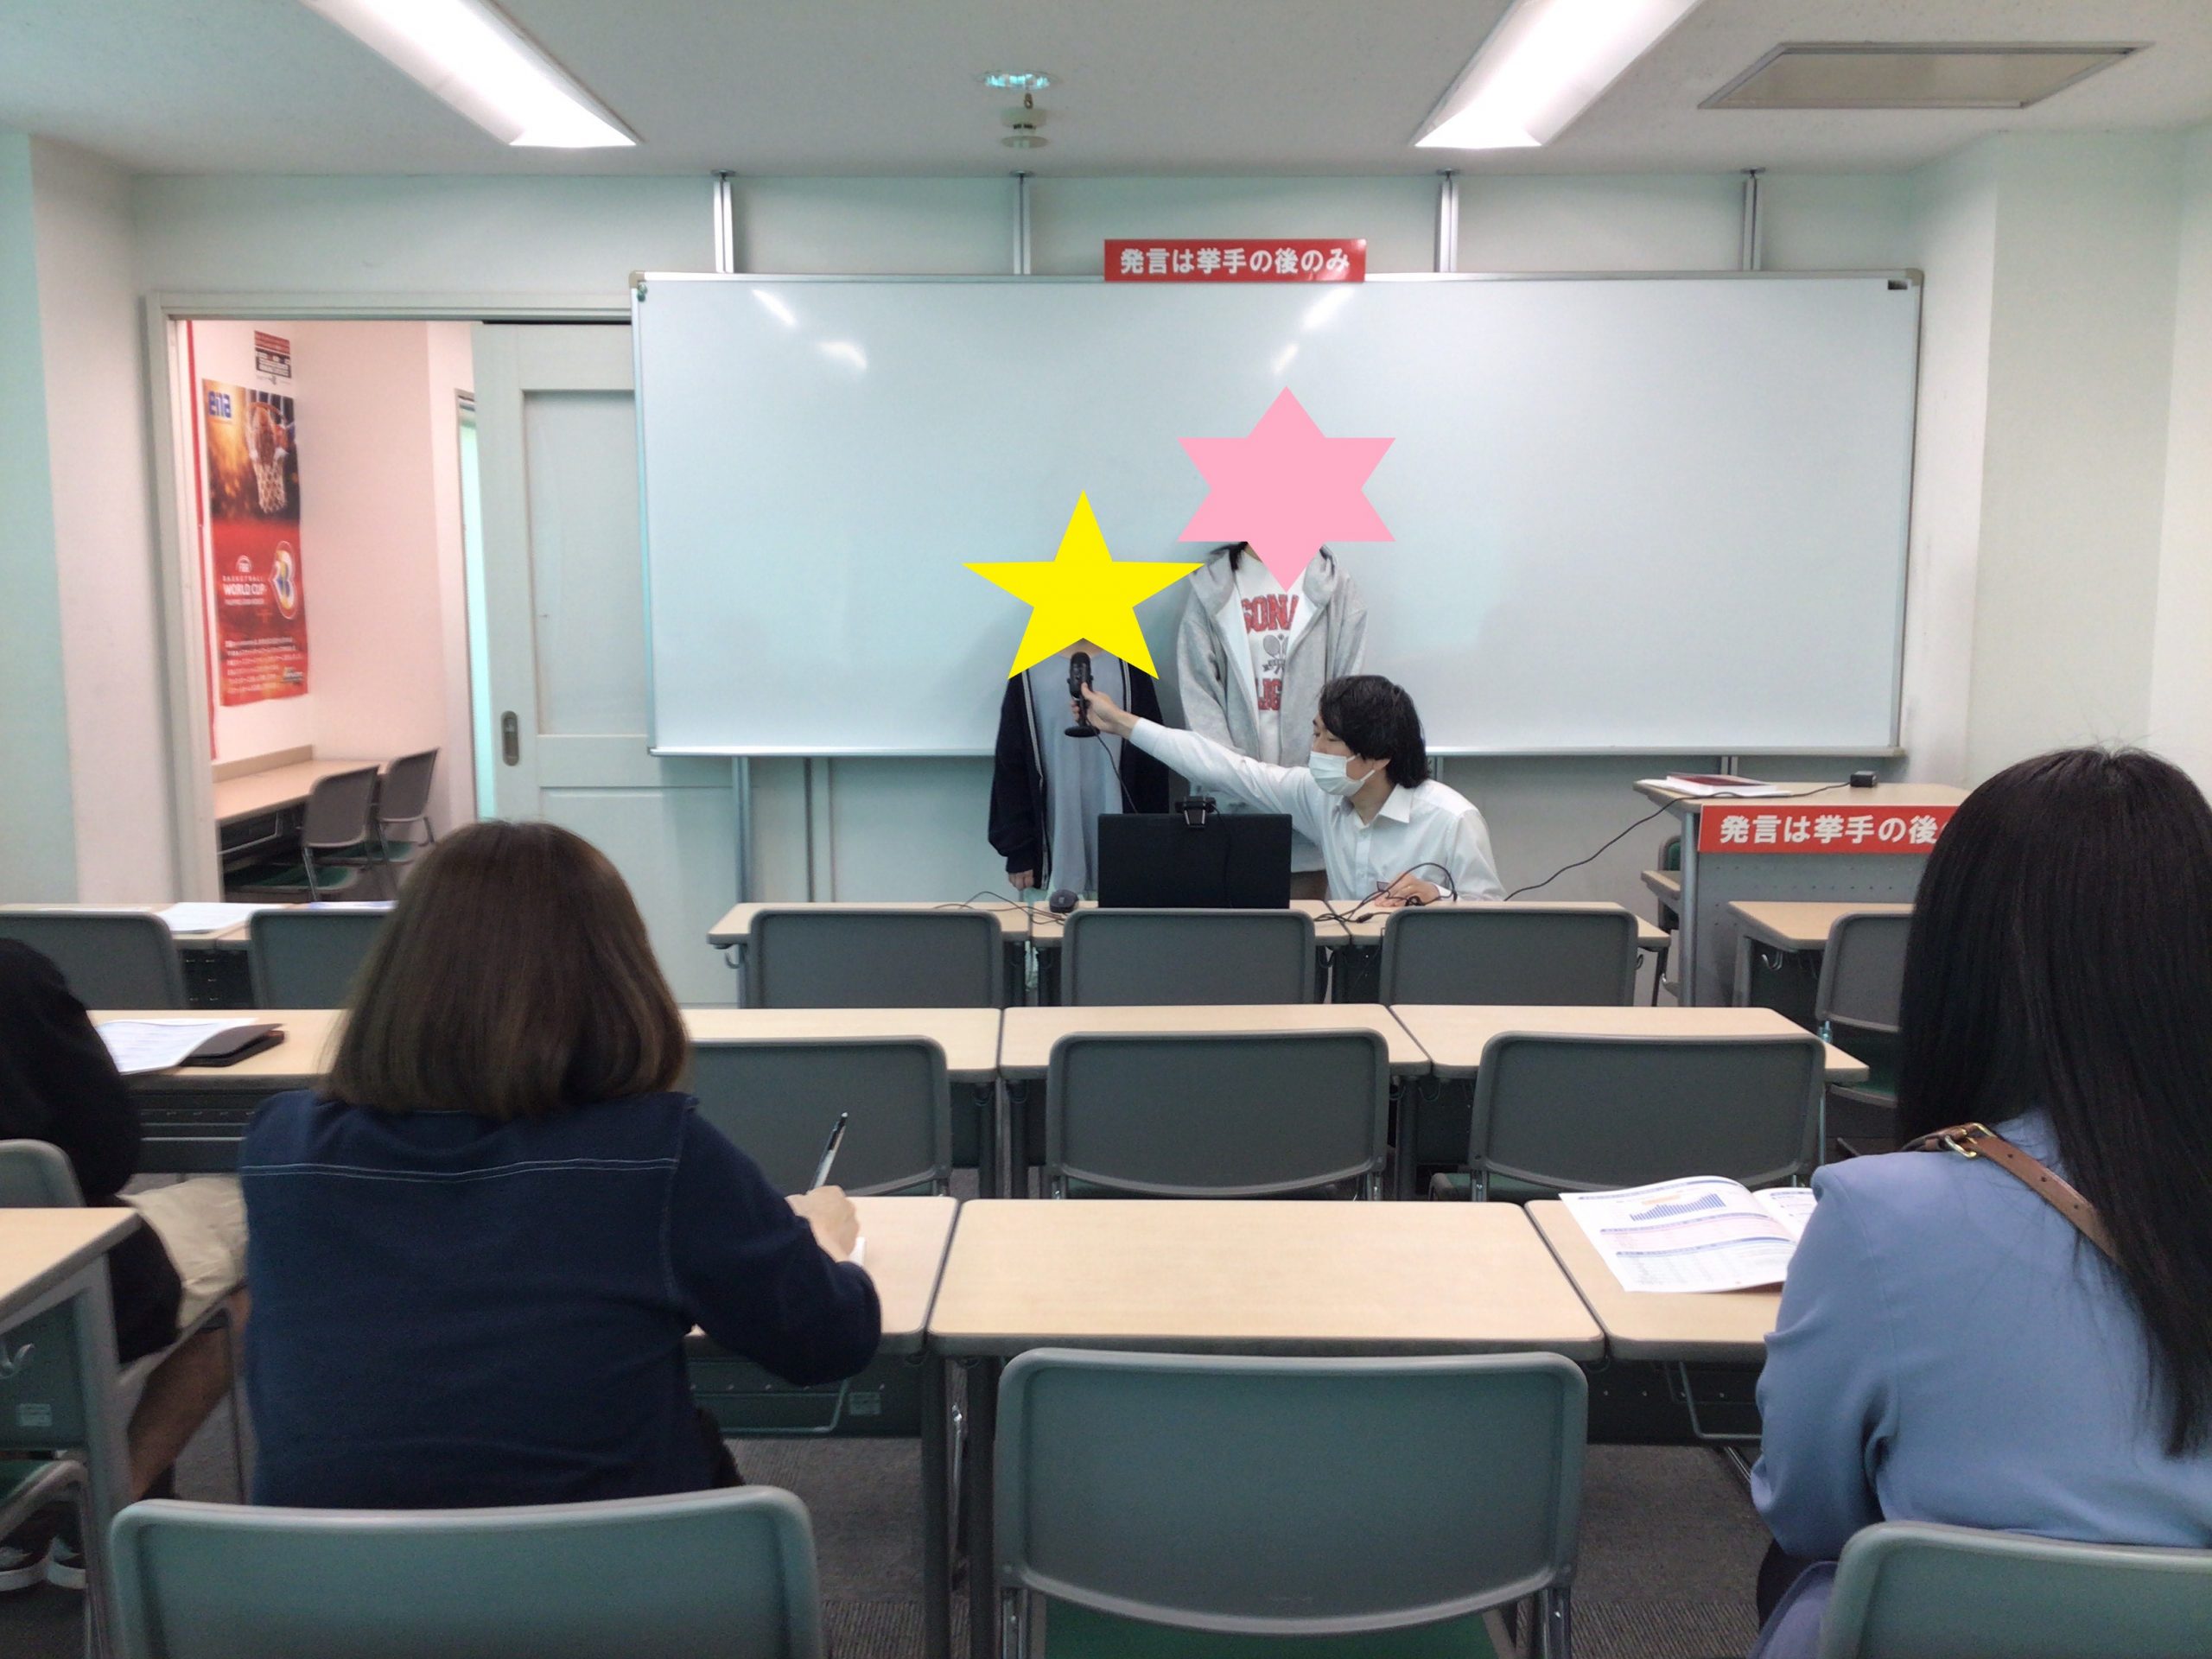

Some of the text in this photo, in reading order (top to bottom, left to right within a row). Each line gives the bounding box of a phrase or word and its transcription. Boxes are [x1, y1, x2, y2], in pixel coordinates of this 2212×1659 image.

[1121, 248, 1350, 274] 発言は挙手の後のみ
[1719, 815, 1949, 844] 発言は挙手の後
